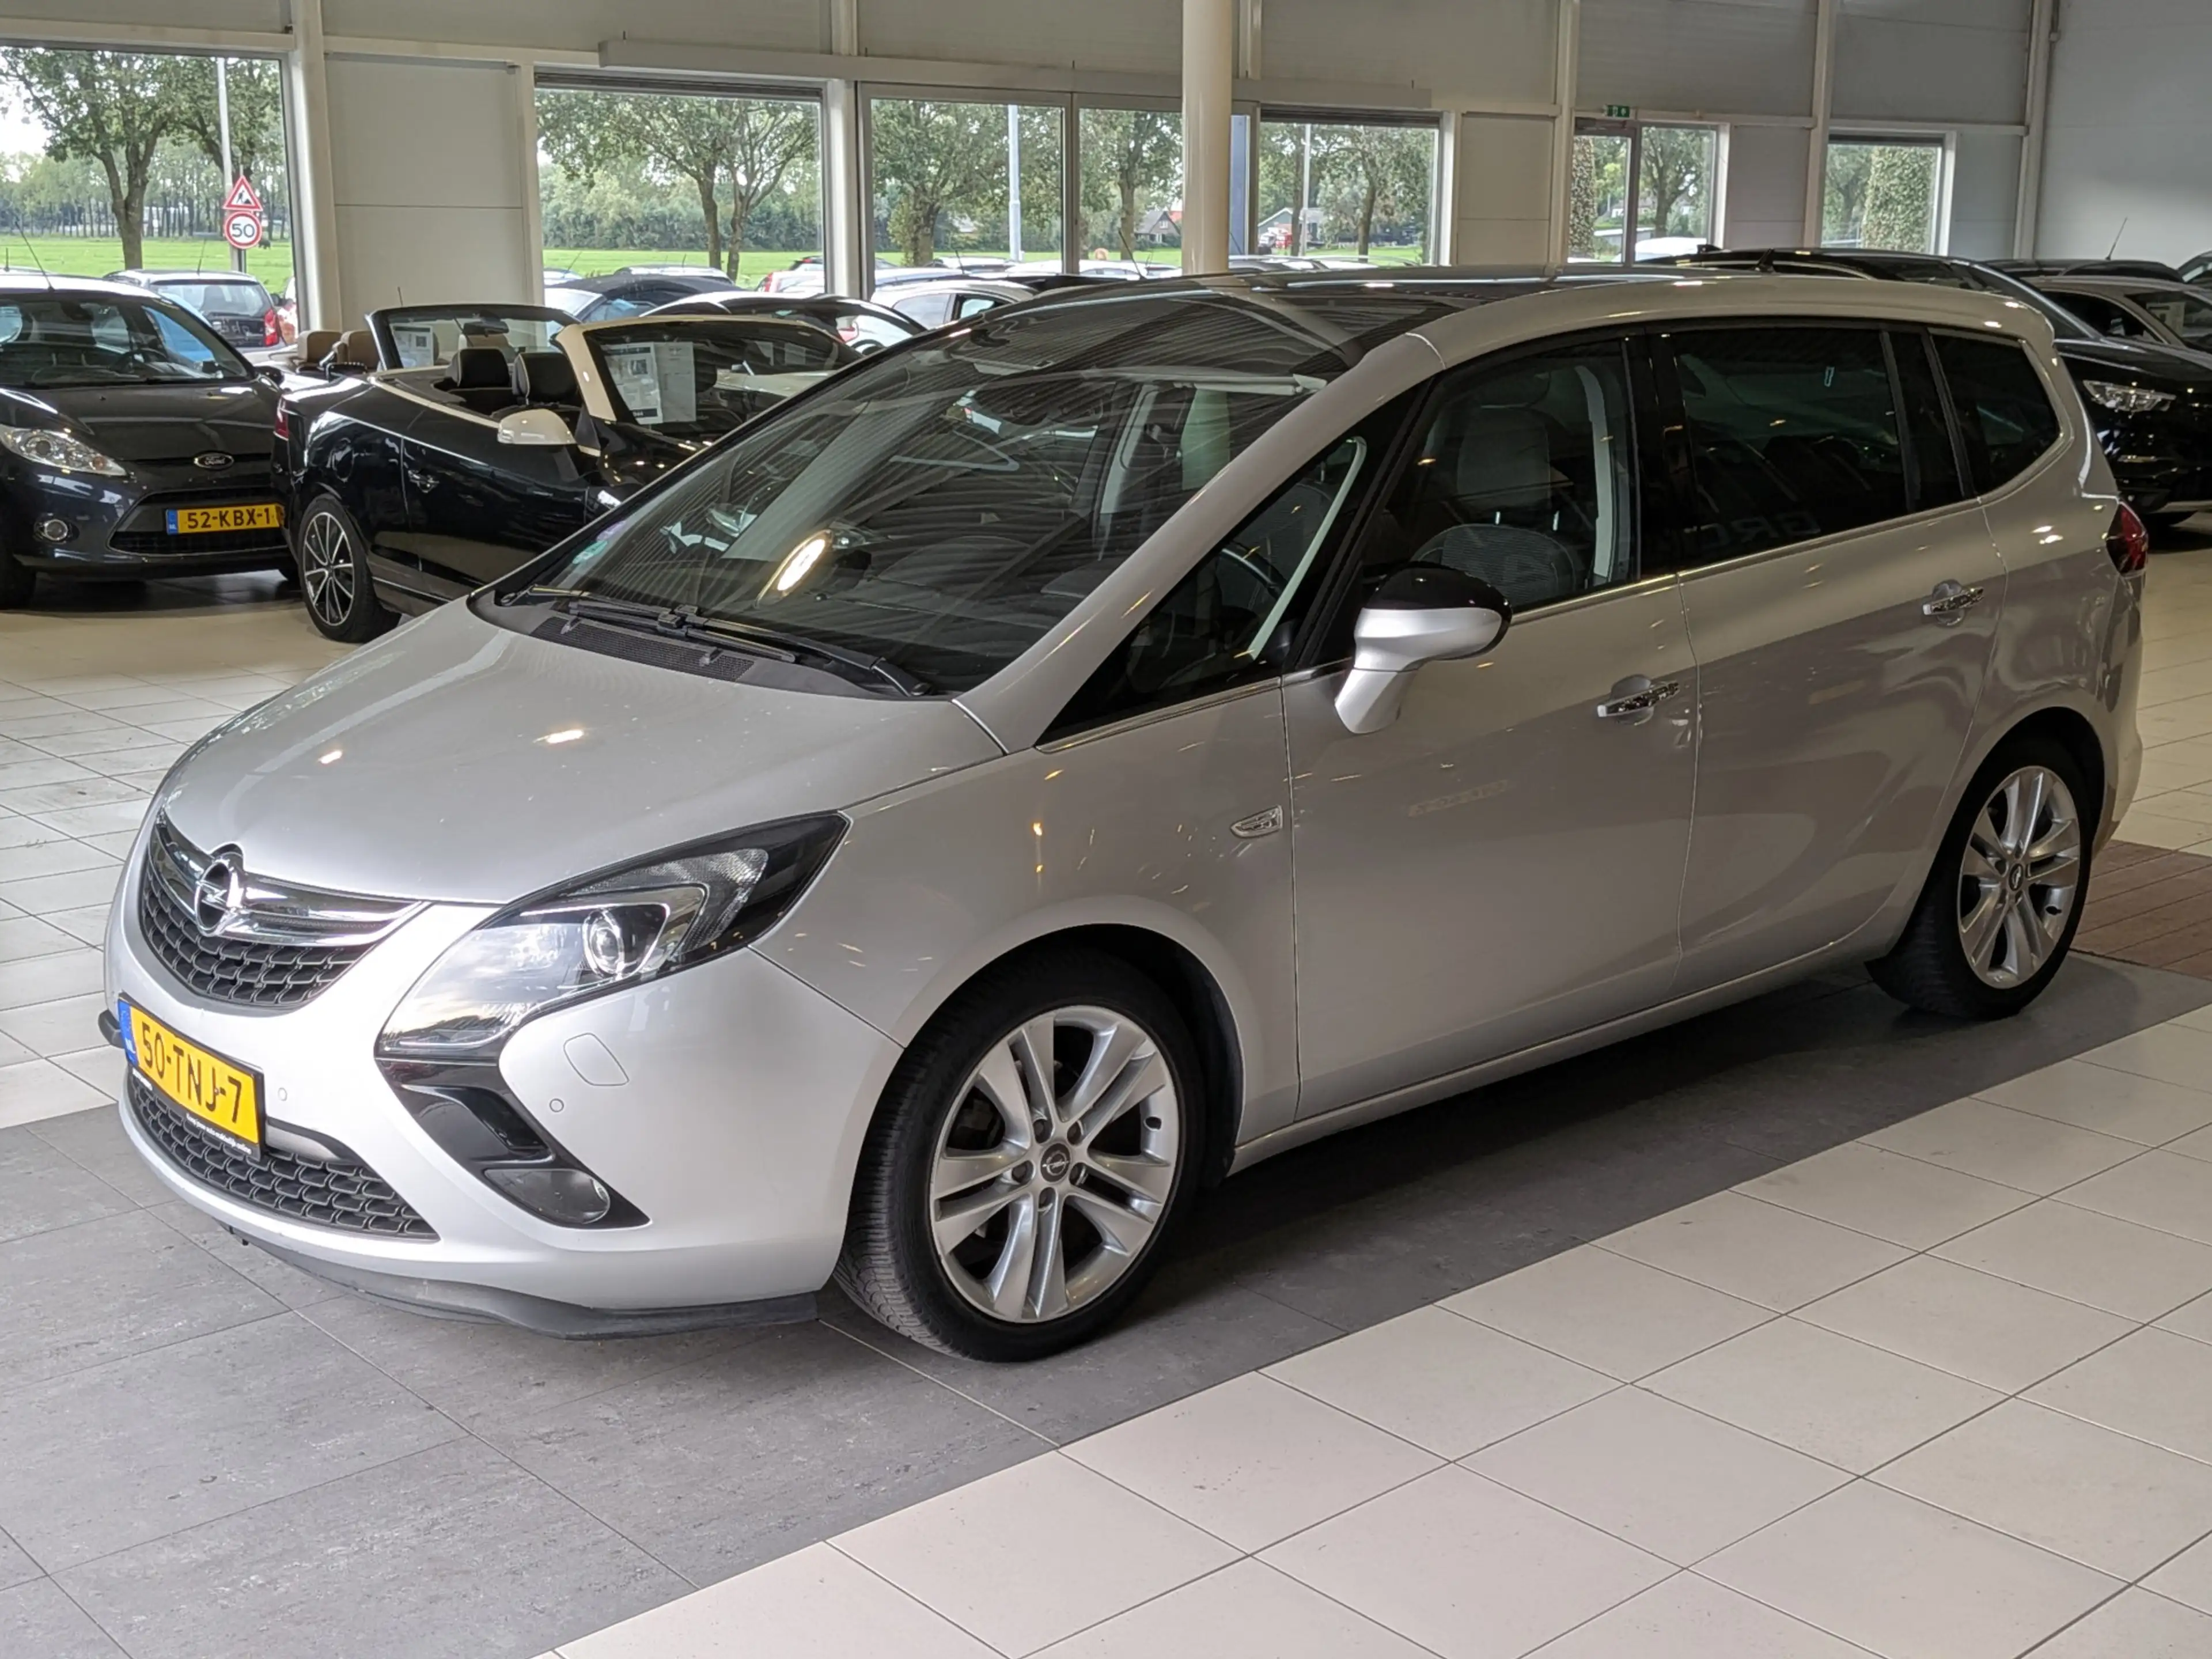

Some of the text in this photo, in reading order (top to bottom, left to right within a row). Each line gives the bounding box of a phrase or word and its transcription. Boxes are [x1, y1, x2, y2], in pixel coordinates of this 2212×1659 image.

[232, 224, 255, 238] 50
[187, 507, 271, 529] 52-KBX-1
[142, 1021, 242, 1124] 50-TNJ-7
